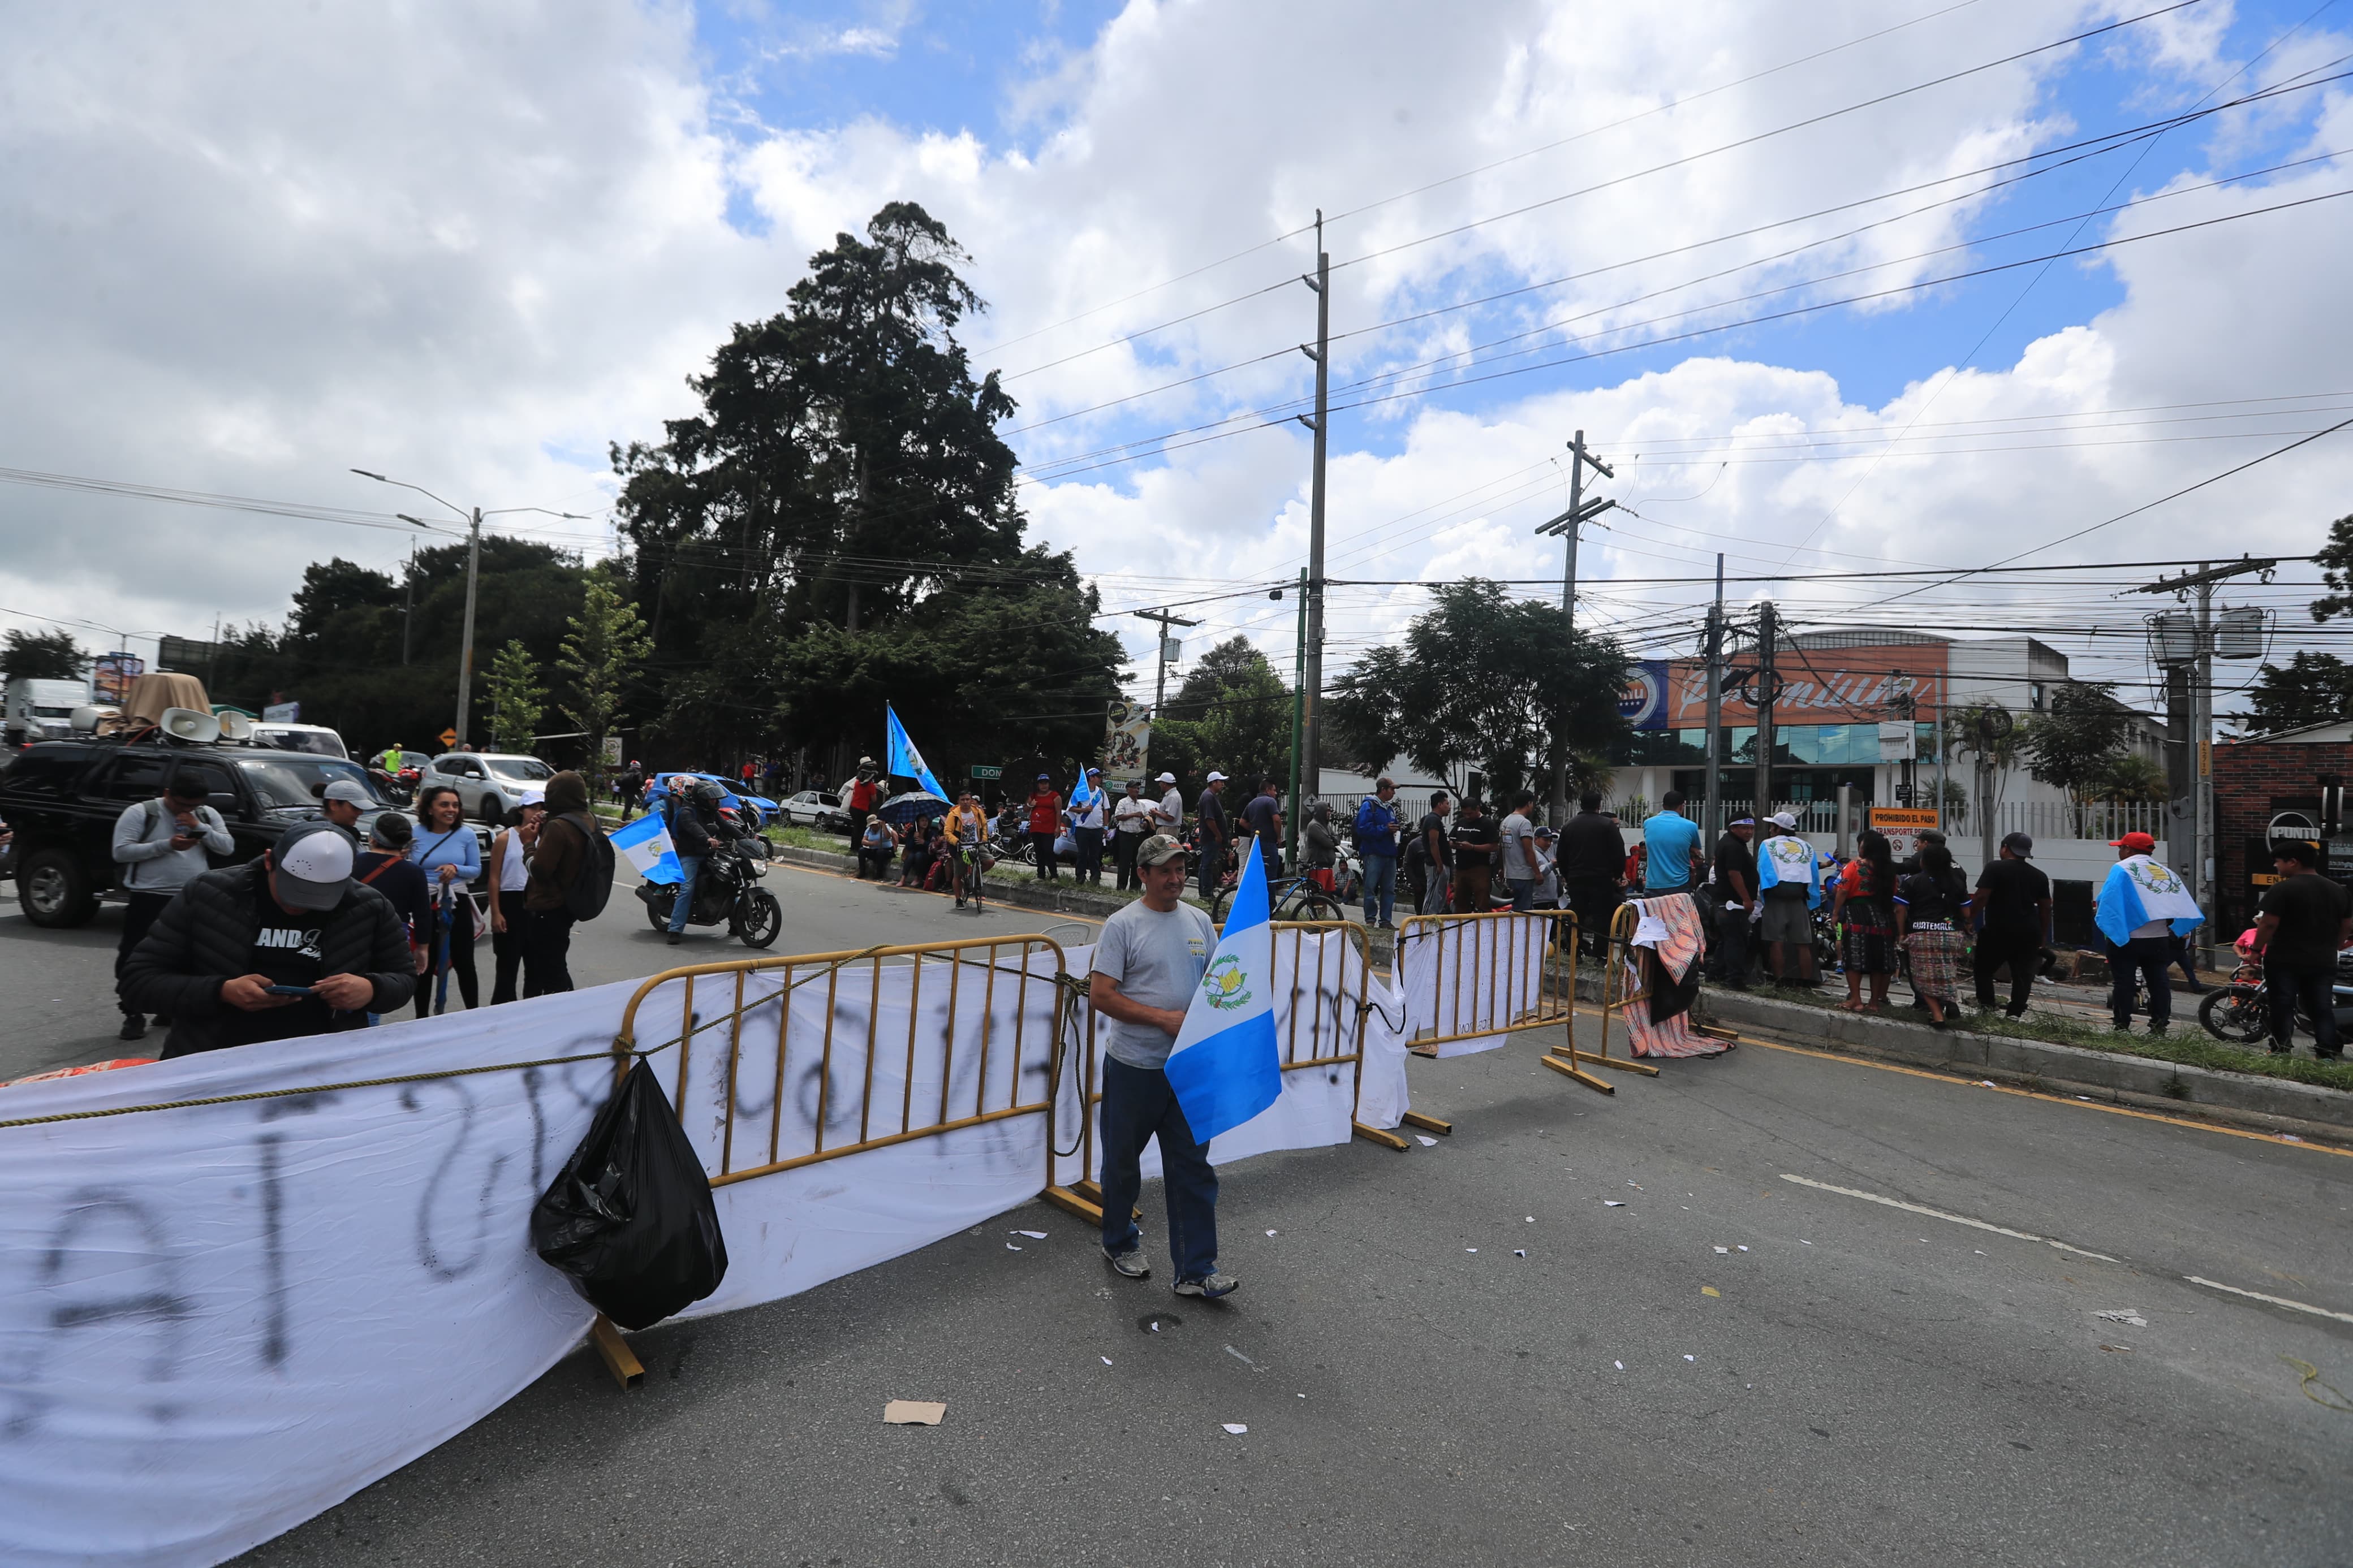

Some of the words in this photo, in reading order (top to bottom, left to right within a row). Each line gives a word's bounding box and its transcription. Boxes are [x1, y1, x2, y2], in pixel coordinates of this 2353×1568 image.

[1875, 814, 1911, 822] PROHIBIDO
[1912, 815, 1919, 823] EL
[1920, 815, 1936, 824] PASO
[1876, 827, 1913, 836] TRANSPORTE
[2271, 826, 2320, 839] PUNTO
